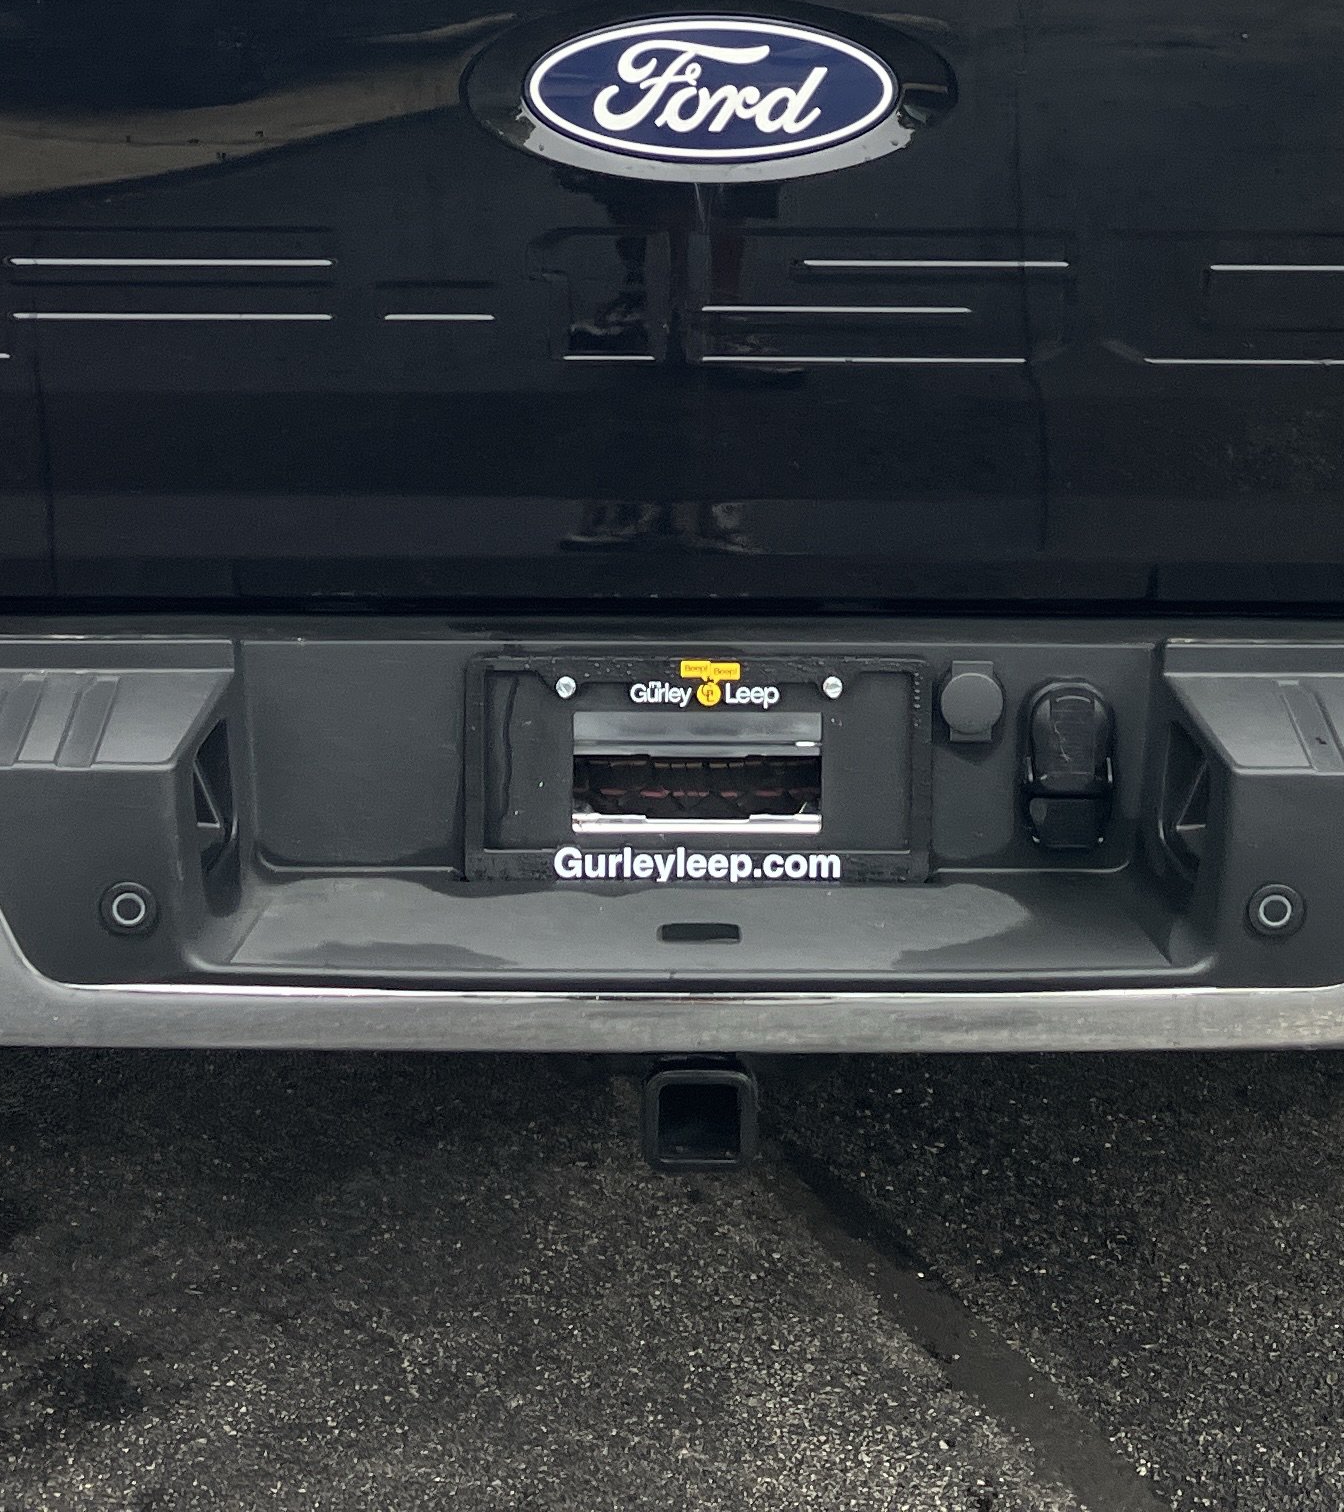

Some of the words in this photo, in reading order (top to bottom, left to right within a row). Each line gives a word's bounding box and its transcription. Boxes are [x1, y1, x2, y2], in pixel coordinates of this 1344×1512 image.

[592, 39, 829, 134] Ford
[725, 682, 780, 710] Leep
[553, 846, 841, 883] Gurleyleep.com
